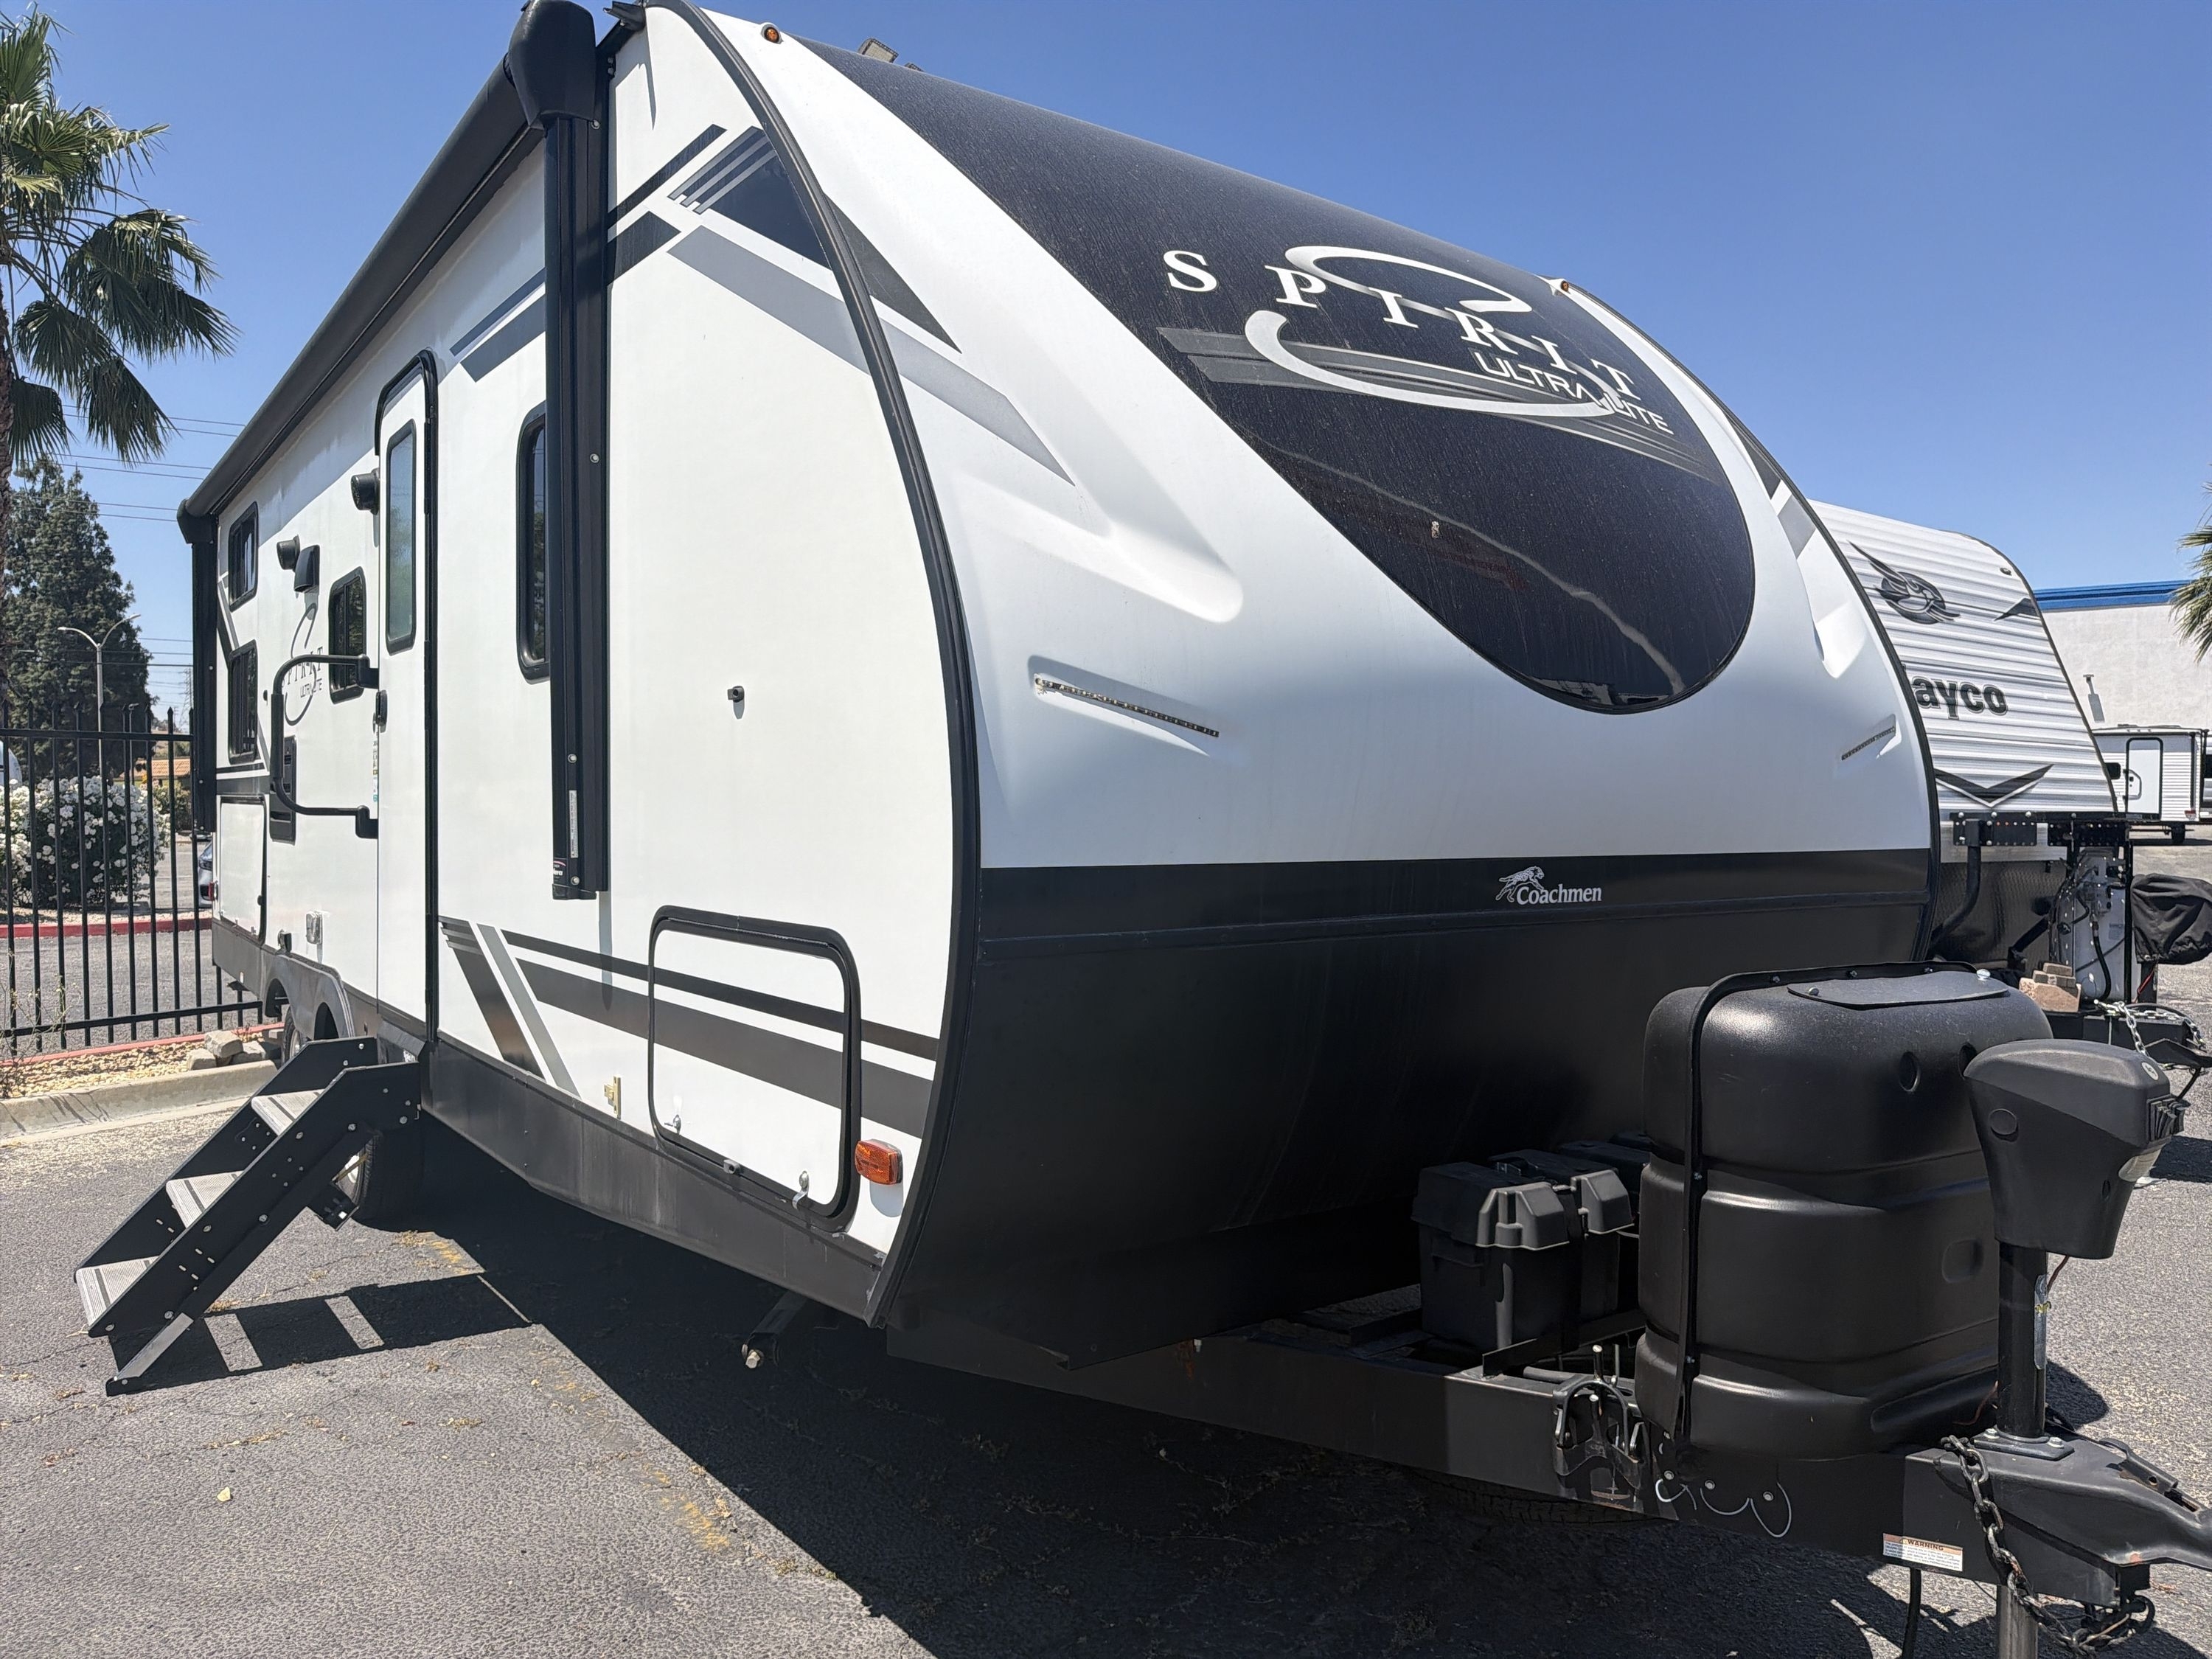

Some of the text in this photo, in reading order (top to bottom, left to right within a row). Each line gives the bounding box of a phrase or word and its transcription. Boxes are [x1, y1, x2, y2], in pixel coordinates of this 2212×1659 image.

[1163, 250, 1641, 400] SPIRIT
[1473, 352, 1604, 407] ULTRA
[282, 646, 323, 686] PIRIT
[1911, 675, 2008, 720] ayco
[1517, 883, 1602, 905] Coachmen
[1907, 1538, 1944, 1551] WARNING
